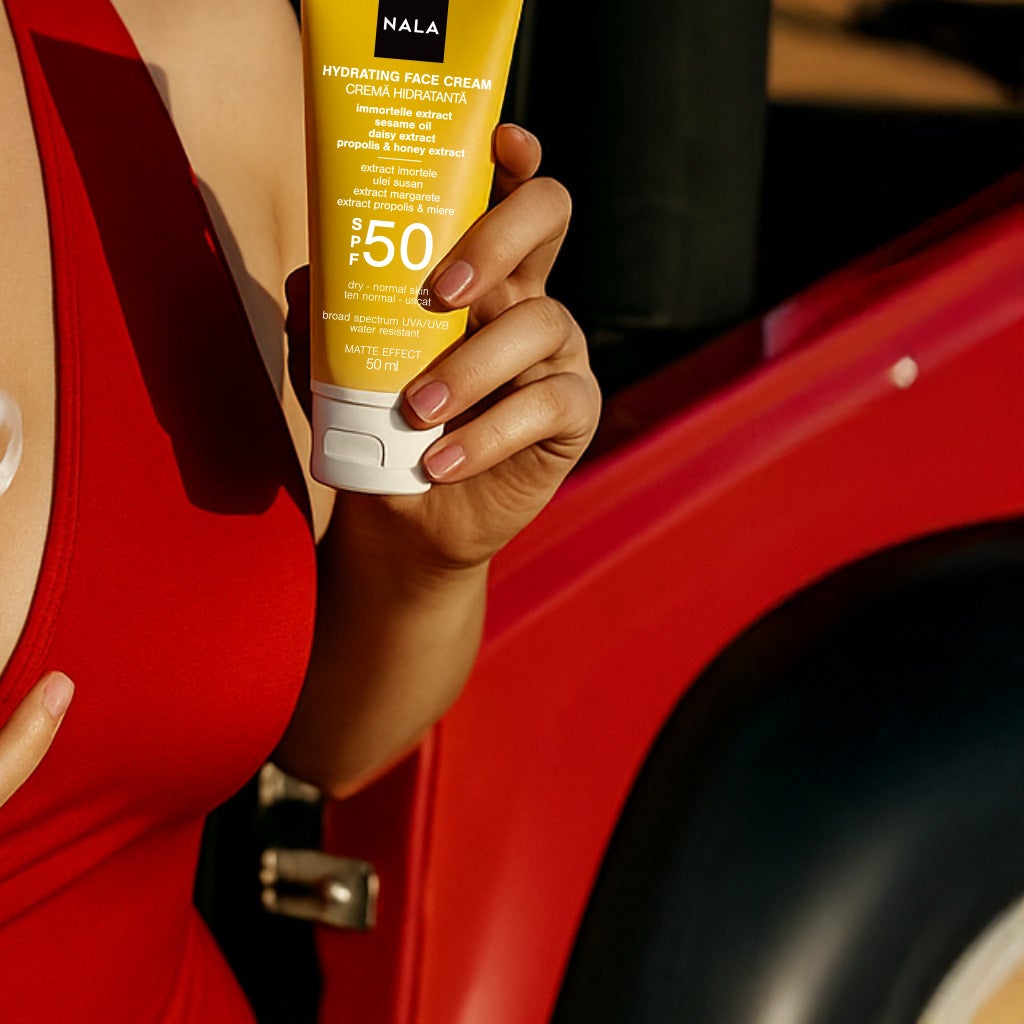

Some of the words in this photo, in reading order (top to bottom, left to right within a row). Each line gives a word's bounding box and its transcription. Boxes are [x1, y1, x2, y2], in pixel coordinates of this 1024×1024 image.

[383, 16, 439, 35] NALA
[322, 64, 400, 83] HYDRATING
[404, 72, 440, 86] FACE
[443, 76, 492, 90] CREAM
[345, 83, 390, 98] CREMĂ
[393, 87, 467, 105] HIDRATANTĂ
[356, 103, 413, 117] immortelle
[415, 109, 453, 121] extract
[374, 118, 416, 129] sesame
[418, 121, 432, 131] oil
[368, 129, 396, 141] daisy
[399, 132, 436, 143] extract
[336, 139, 380, 151] propolis
[383, 142, 391, 152] &
[393, 142, 426, 156] honey
[428, 147, 466, 158] extract
[360, 163, 394, 175] extract
[397, 165, 438, 178] imortele
[372, 176, 391, 186] ulei
[393, 179, 423, 189] susan
[353, 187, 387, 198] extract
[390, 190, 441, 203] margarete
[337, 197, 371, 209] extract
[373, 200, 414, 213] propolis
[416, 204, 424, 213] &
[426, 205, 455, 216] miere
[362, 219, 434, 271] 50
[347, 280, 364, 291] dry
[372, 283, 407, 294] normal
[344, 290, 359, 300] ten
[362, 292, 396, 303] normal
[405, 297, 432, 307] uscat
[322, 310, 351, 322] broad
[353, 314, 399, 326] spectrum
[402, 318, 449, 330] UVA/UVB
[349, 325, 375, 334] water
[378, 327, 420, 338] resistant
[344, 344, 379, 356] MATTE
[382, 347, 422, 360] EFFECT
[365, 357, 382, 370] 50
[384, 360, 399, 372] ml
